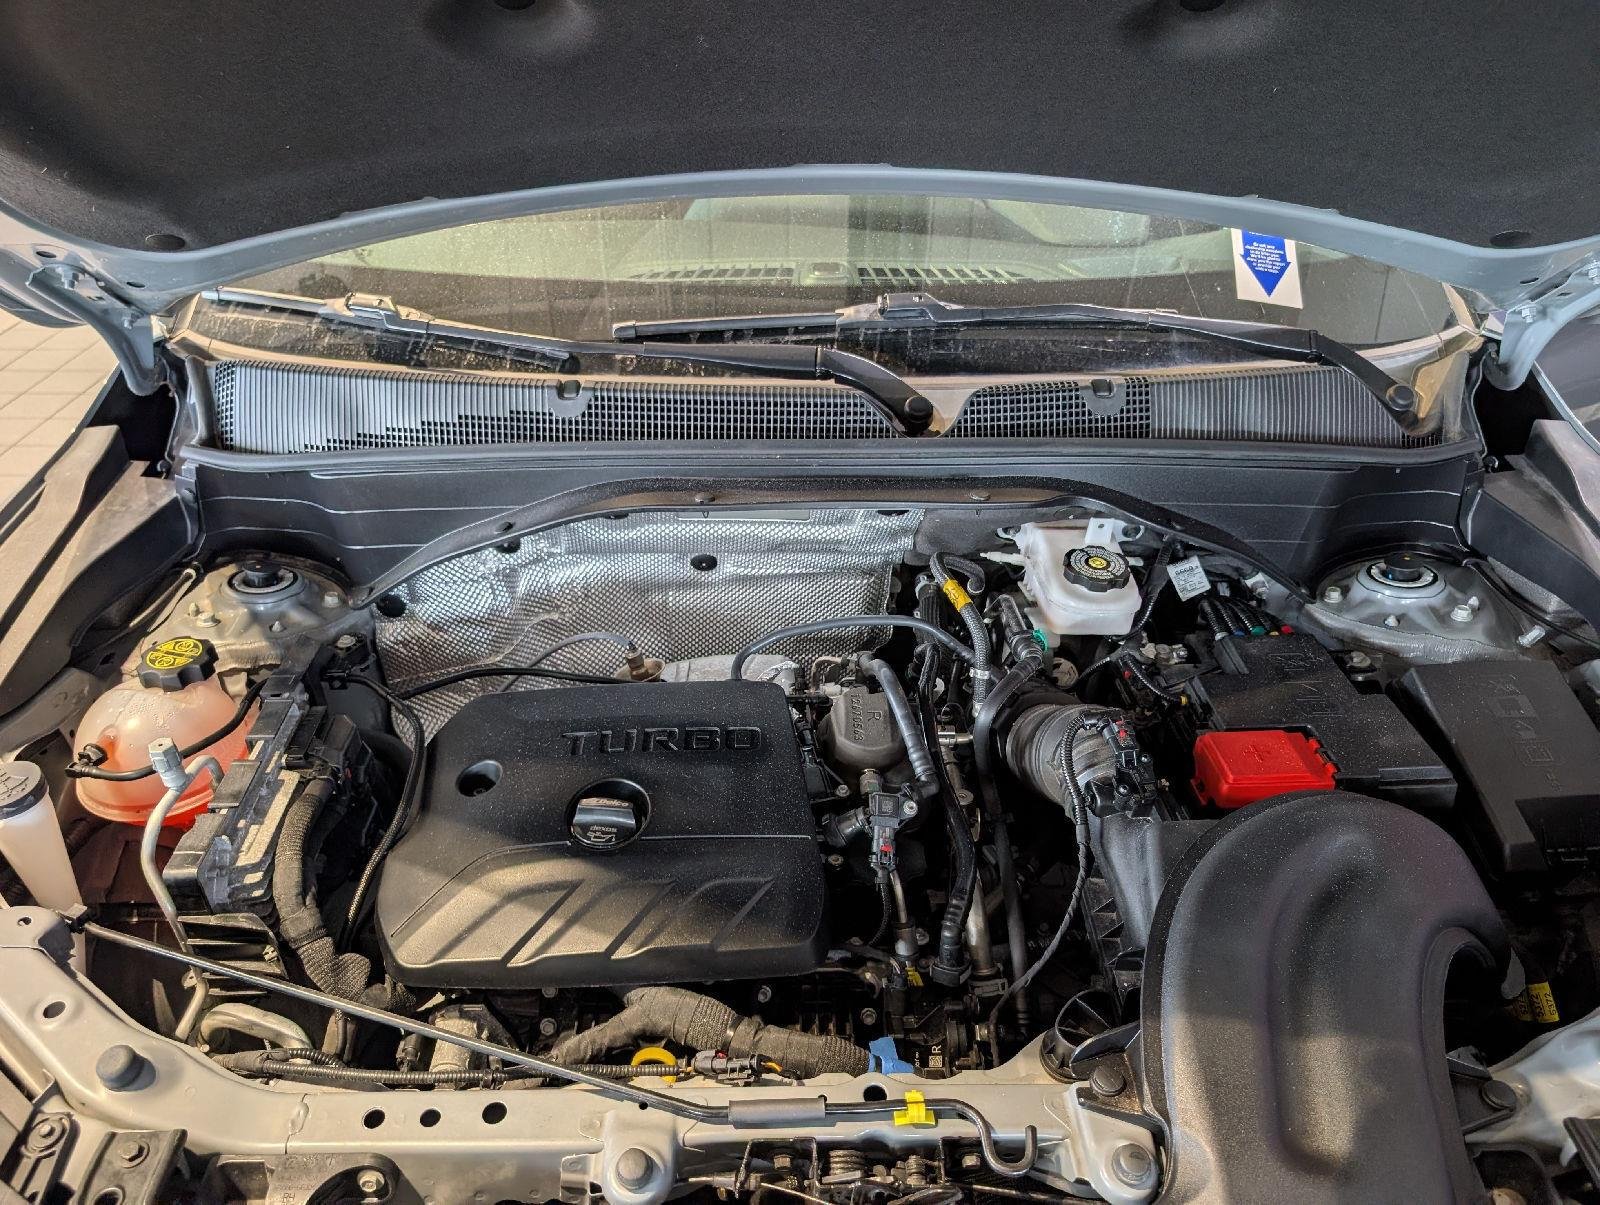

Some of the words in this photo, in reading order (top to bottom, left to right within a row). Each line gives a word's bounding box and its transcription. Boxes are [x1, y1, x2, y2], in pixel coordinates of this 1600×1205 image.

[867, 710, 882, 722] R
[561, 726, 762, 755] TURBO
[931, 1044, 942, 1054] R
